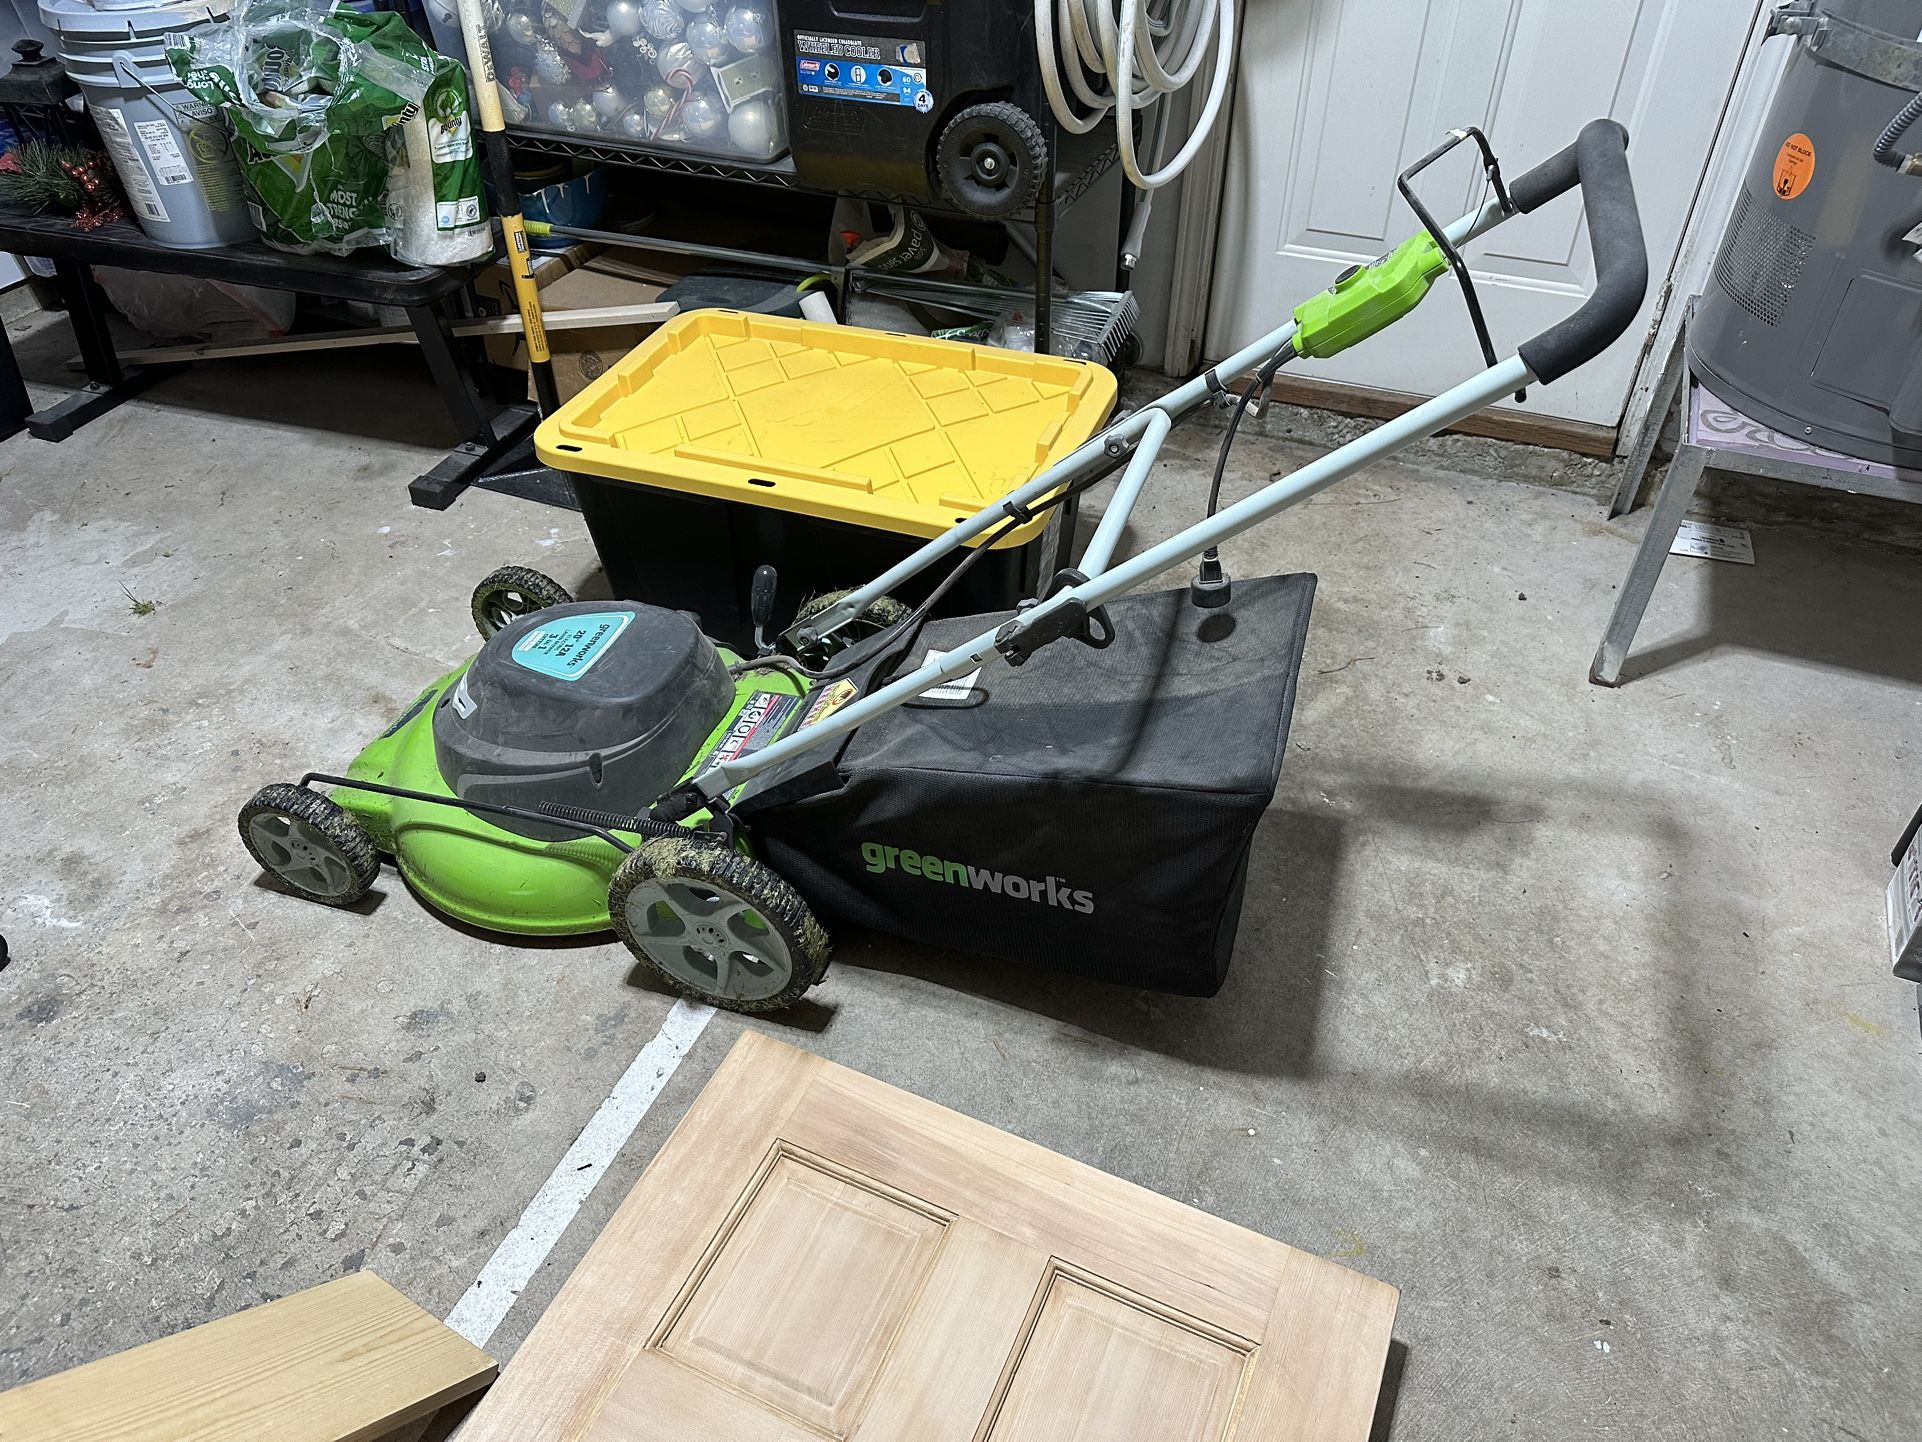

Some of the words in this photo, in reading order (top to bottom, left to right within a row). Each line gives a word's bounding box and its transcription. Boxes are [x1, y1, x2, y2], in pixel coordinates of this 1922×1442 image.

[796, 34, 818, 42] OFFICIALLY
[819, 36, 838, 44] LICENSED
[838, 38, 862, 46] COLLEGIATE
[798, 40, 845, 56] WHEELED
[844, 44, 881, 60] COOLER
[187, 81, 214, 90] Long
[918, 94, 926, 103] 4
[192, 108, 213, 117] AVISO
[440, 116, 462, 135] Bounty
[1798, 147, 1812, 157] BLOCK
[330, 190, 357, 206] MOST
[899, 228, 922, 262] paver
[555, 643, 574, 657] 12A
[567, 623, 610, 668] greenworks
[861, 842, 1095, 914] greenworks
